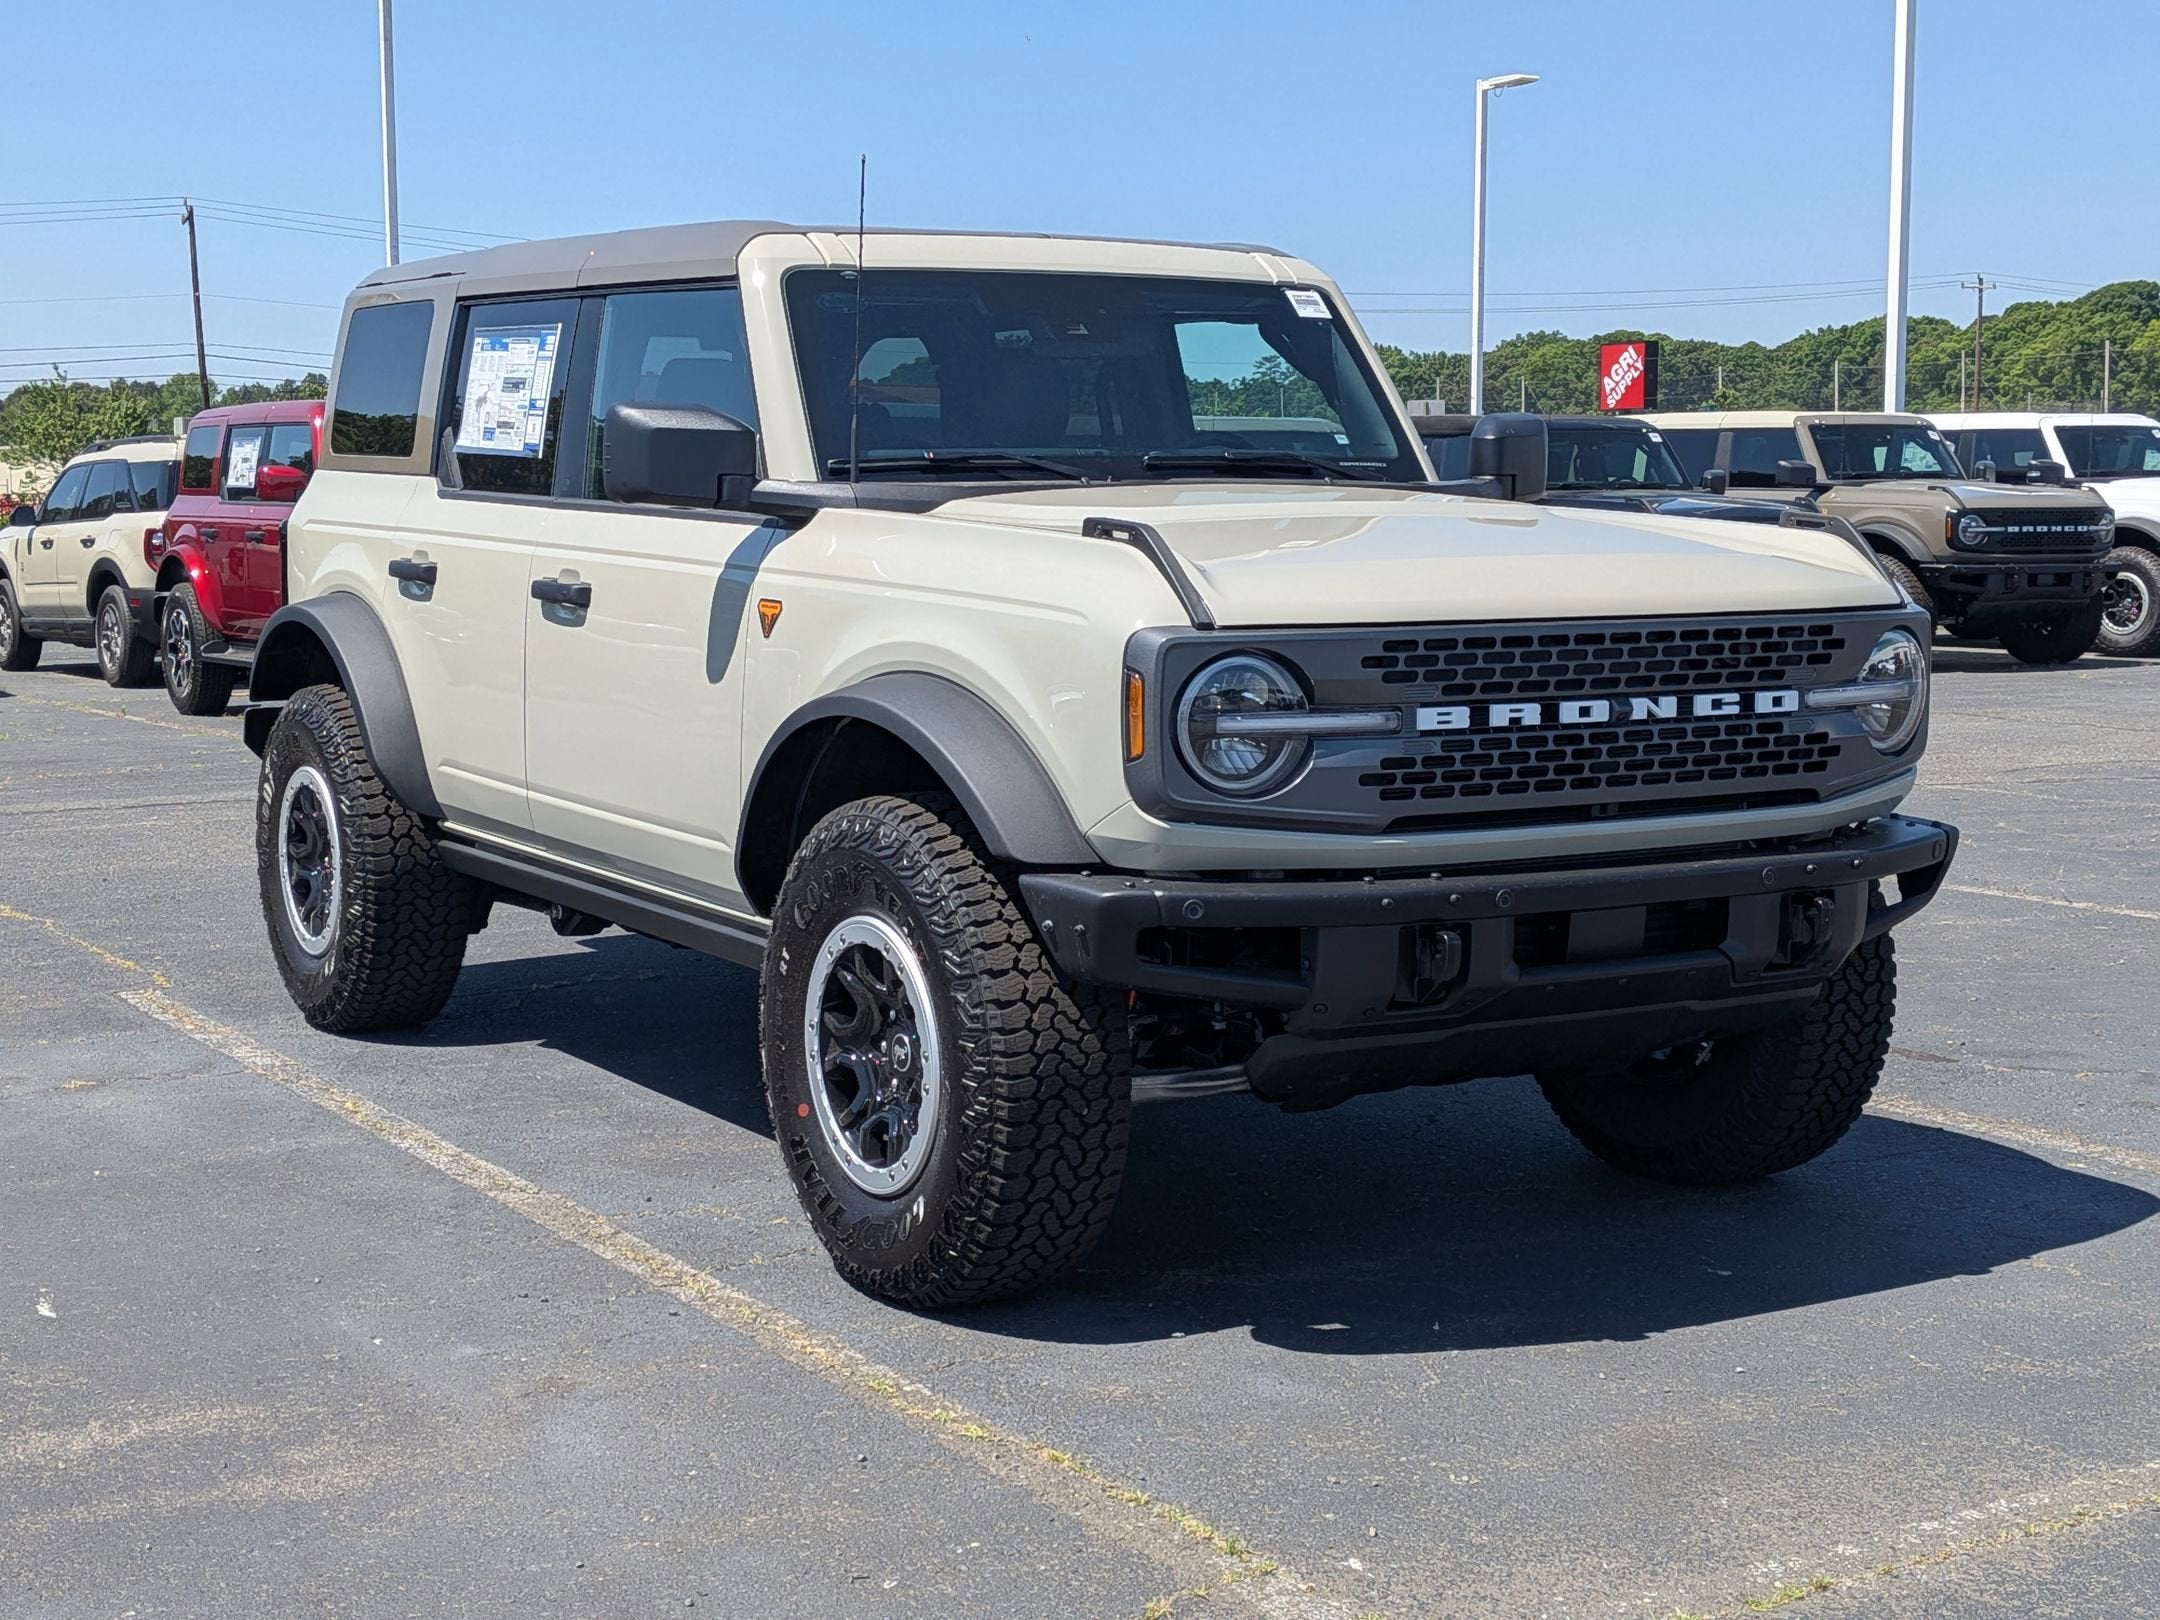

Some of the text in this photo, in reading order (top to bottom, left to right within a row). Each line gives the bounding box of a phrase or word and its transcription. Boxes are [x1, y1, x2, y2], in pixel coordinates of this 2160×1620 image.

[1604, 345, 1638, 395] AGRI
[1607, 355, 1644, 409] SUPPLY
[2007, 525, 2088, 533] BRONCO
[1416, 690, 1799, 731] BRONCO
